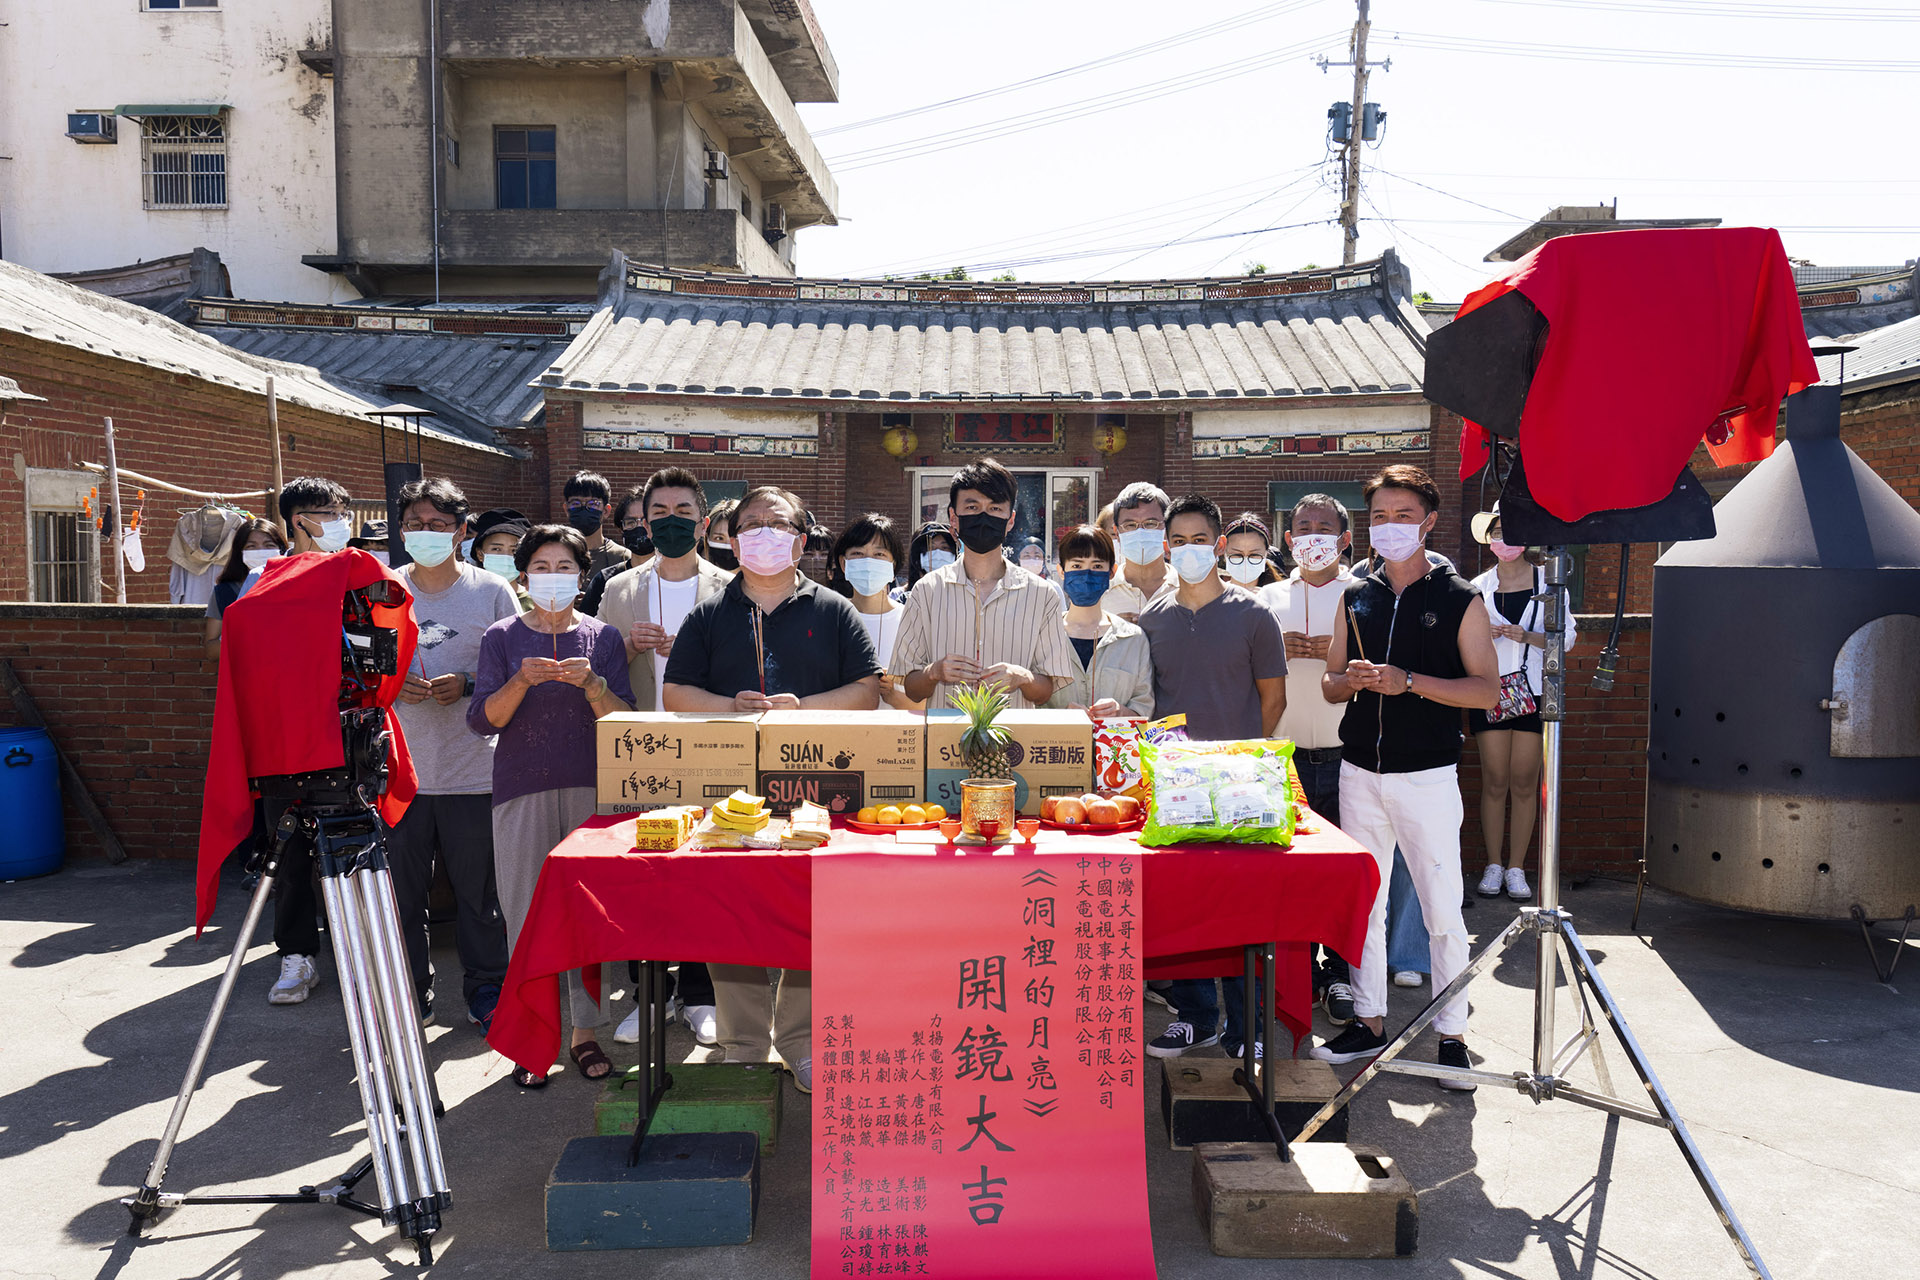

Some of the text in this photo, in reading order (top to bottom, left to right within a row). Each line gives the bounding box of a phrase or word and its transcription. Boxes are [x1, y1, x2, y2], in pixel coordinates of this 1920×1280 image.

[780, 740, 824, 763] SUÁN
[1029, 745, 1085, 765] 活動版
[768, 776, 819, 803] SUÁN
[1074, 857, 1094, 1067] 中天電視股份有限公司
[1116, 857, 1136, 1087] 台灣大哥大股份有限公司
[1021, 868, 1059, 1118] 《洞裡的月亮》
[1096, 857, 1116, 1110] 中國電視事業股份有限公司
[841, 1014, 856, 1084] 製片團隊
[859, 1049, 873, 1083] 製片
[876, 1049, 891, 1083] 編劇
[893, 1048, 909, 1083] 導演
[911, 1031, 927, 1081] 製作人
[822, 1015, 838, 1195] 及全體演員及工作人員
[929, 1013, 945, 1155] 力揚電影有限公司
[951, 955, 1017, 1227] 開鏡大吉
[876, 1096, 892, 1148] 王昭華
[858, 1179, 874, 1213] 燈光
[876, 1177, 892, 1212] 造型
[895, 1177, 910, 1212] 美術
[912, 1176, 927, 1211] 攝影
